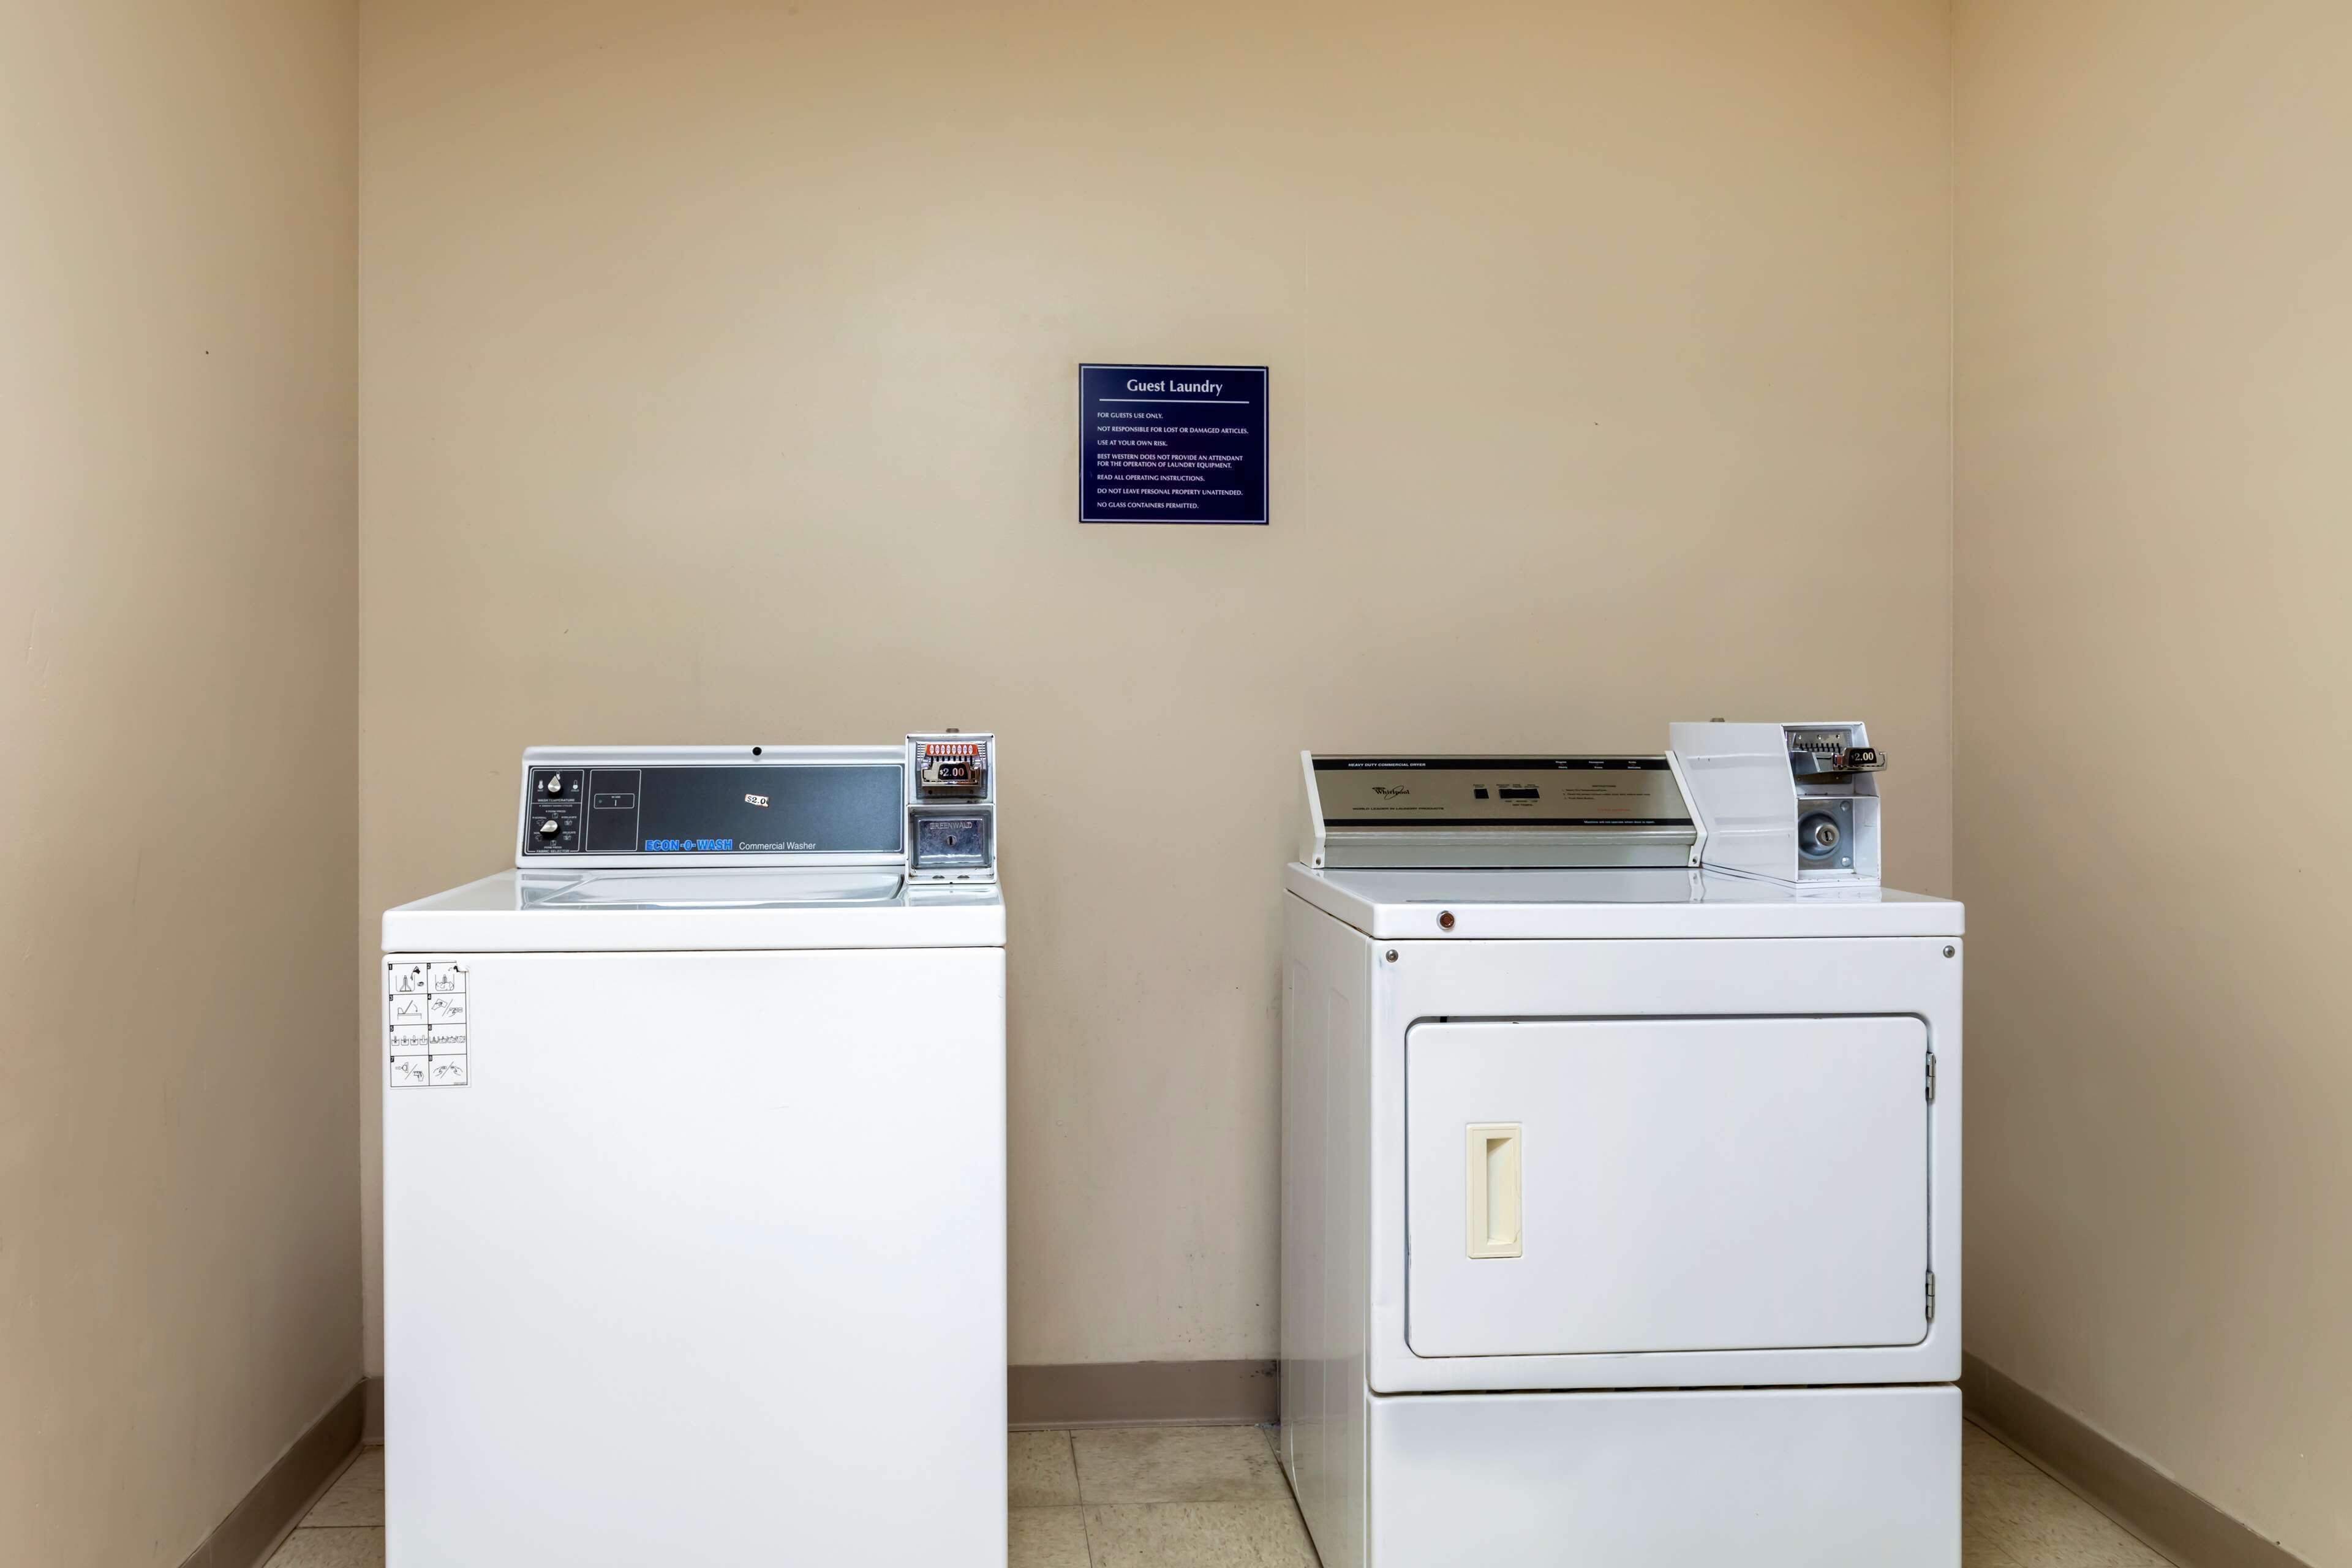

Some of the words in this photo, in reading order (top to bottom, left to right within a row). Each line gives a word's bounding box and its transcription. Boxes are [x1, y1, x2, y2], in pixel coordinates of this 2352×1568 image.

[1127, 379, 1165, 392] Guest
[1170, 380, 1223, 396] Laundry
[645, 839, 733, 851] ECON-O-WASH
